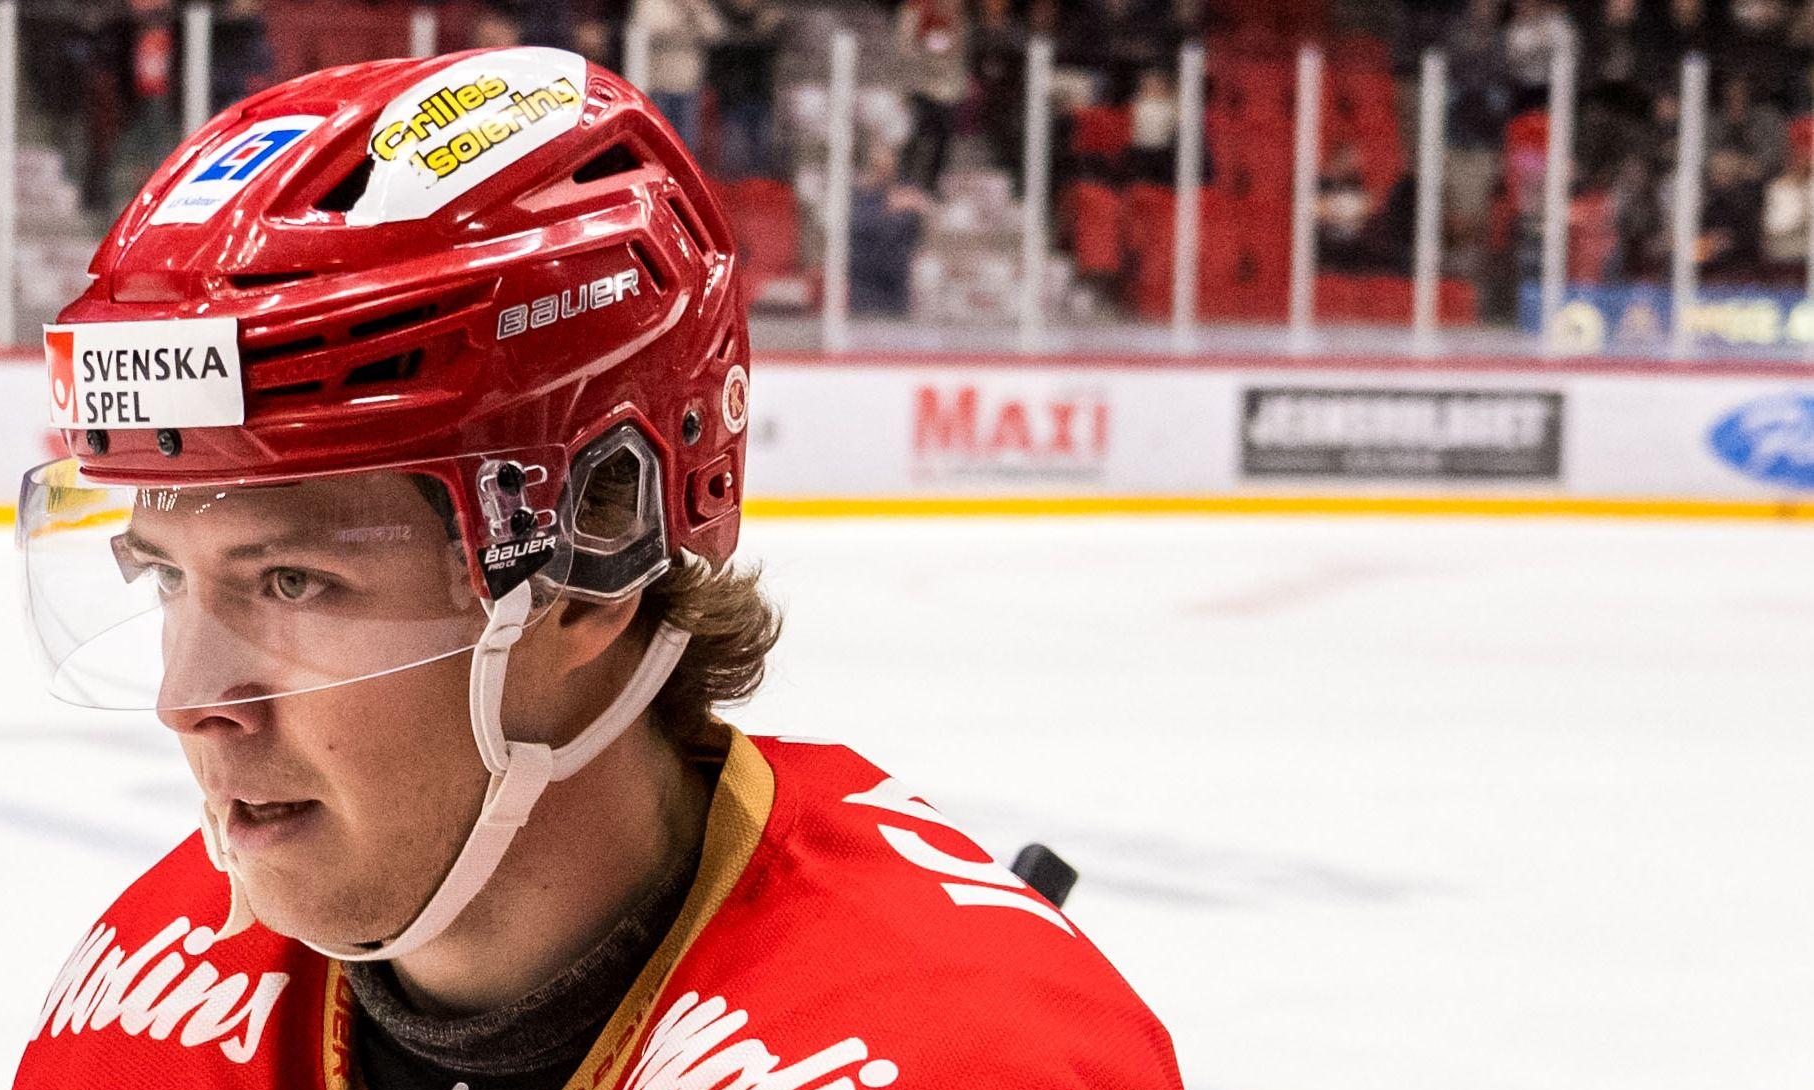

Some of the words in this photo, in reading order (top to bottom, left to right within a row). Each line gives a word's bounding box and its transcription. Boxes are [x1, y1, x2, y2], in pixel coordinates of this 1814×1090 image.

[496, 267, 641, 341] BAUER
[82, 346, 229, 383] SVENSKA
[86, 391, 151, 424] SPEL
[485, 537, 557, 564] BAUER
[488, 560, 505, 571] PRO
[506, 559, 516, 568] CE
